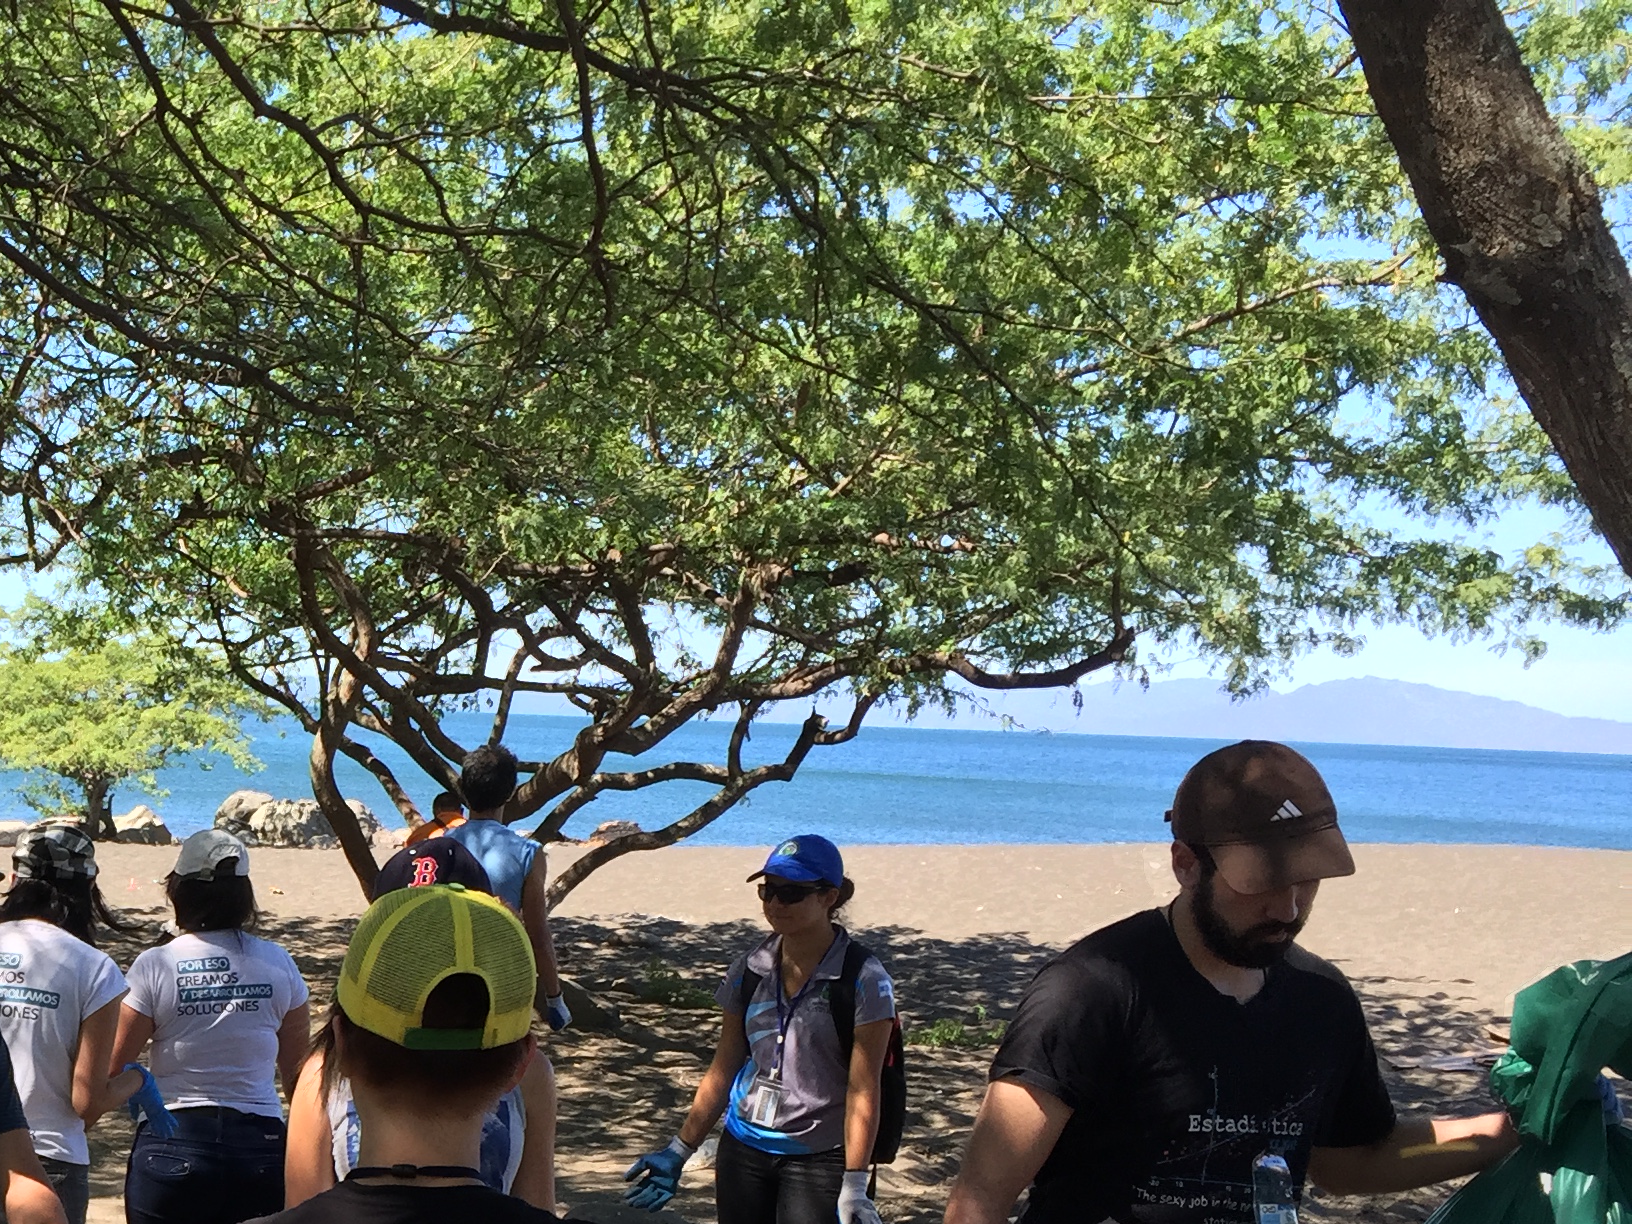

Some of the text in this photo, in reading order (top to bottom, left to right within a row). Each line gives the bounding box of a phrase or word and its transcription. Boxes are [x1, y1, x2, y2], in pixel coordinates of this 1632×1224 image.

[408, 856, 439, 888] B
[178, 958, 228, 971] POR ESO
[176, 972, 239, 988] CREAMOS
[180, 986, 271, 1000] Y DESARROLLAMOS
[177, 1001, 259, 1017] SOLUCIONES
[1159, 1194, 1186, 1209] sexy
[1188, 1195, 1208, 1209] job
